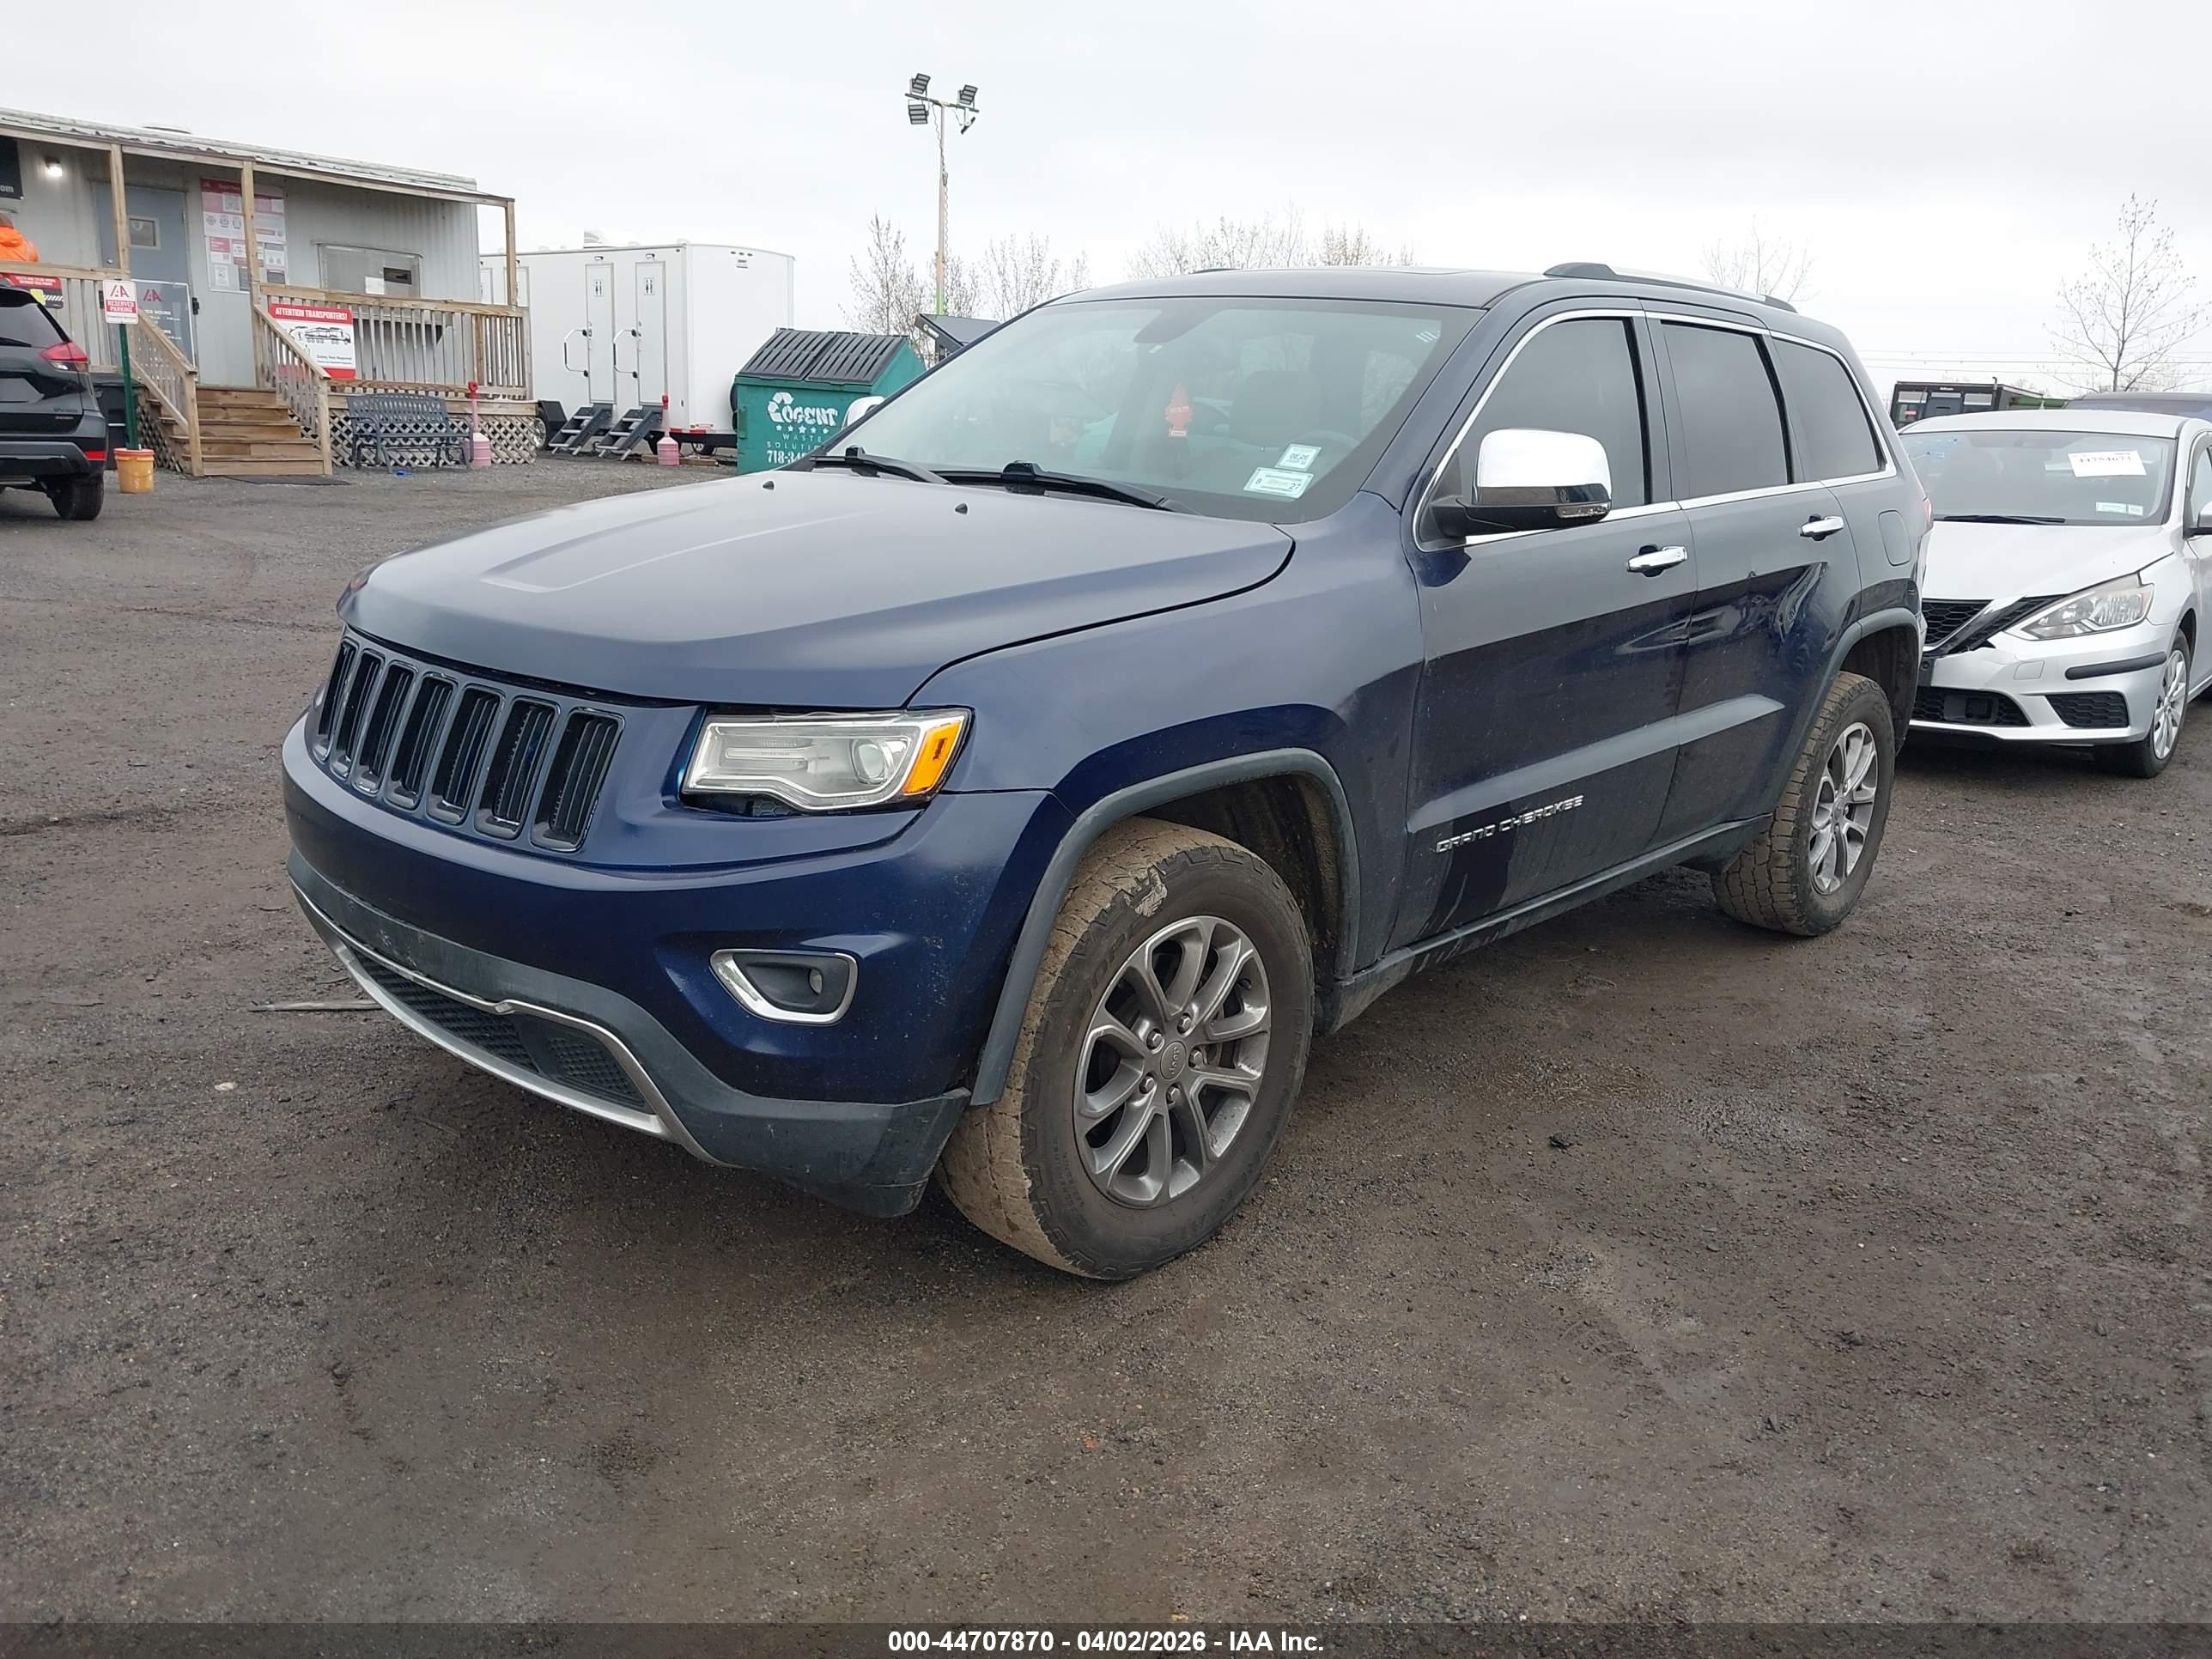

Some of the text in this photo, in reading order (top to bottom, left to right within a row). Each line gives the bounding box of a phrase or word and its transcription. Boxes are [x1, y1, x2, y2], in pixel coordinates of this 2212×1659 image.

[275, 307, 348, 320] ATTENTION TRANSPORTERS!
[782, 433, 822, 442] WASTE
[1436, 794, 1584, 853] GRAND CHEROKEE
